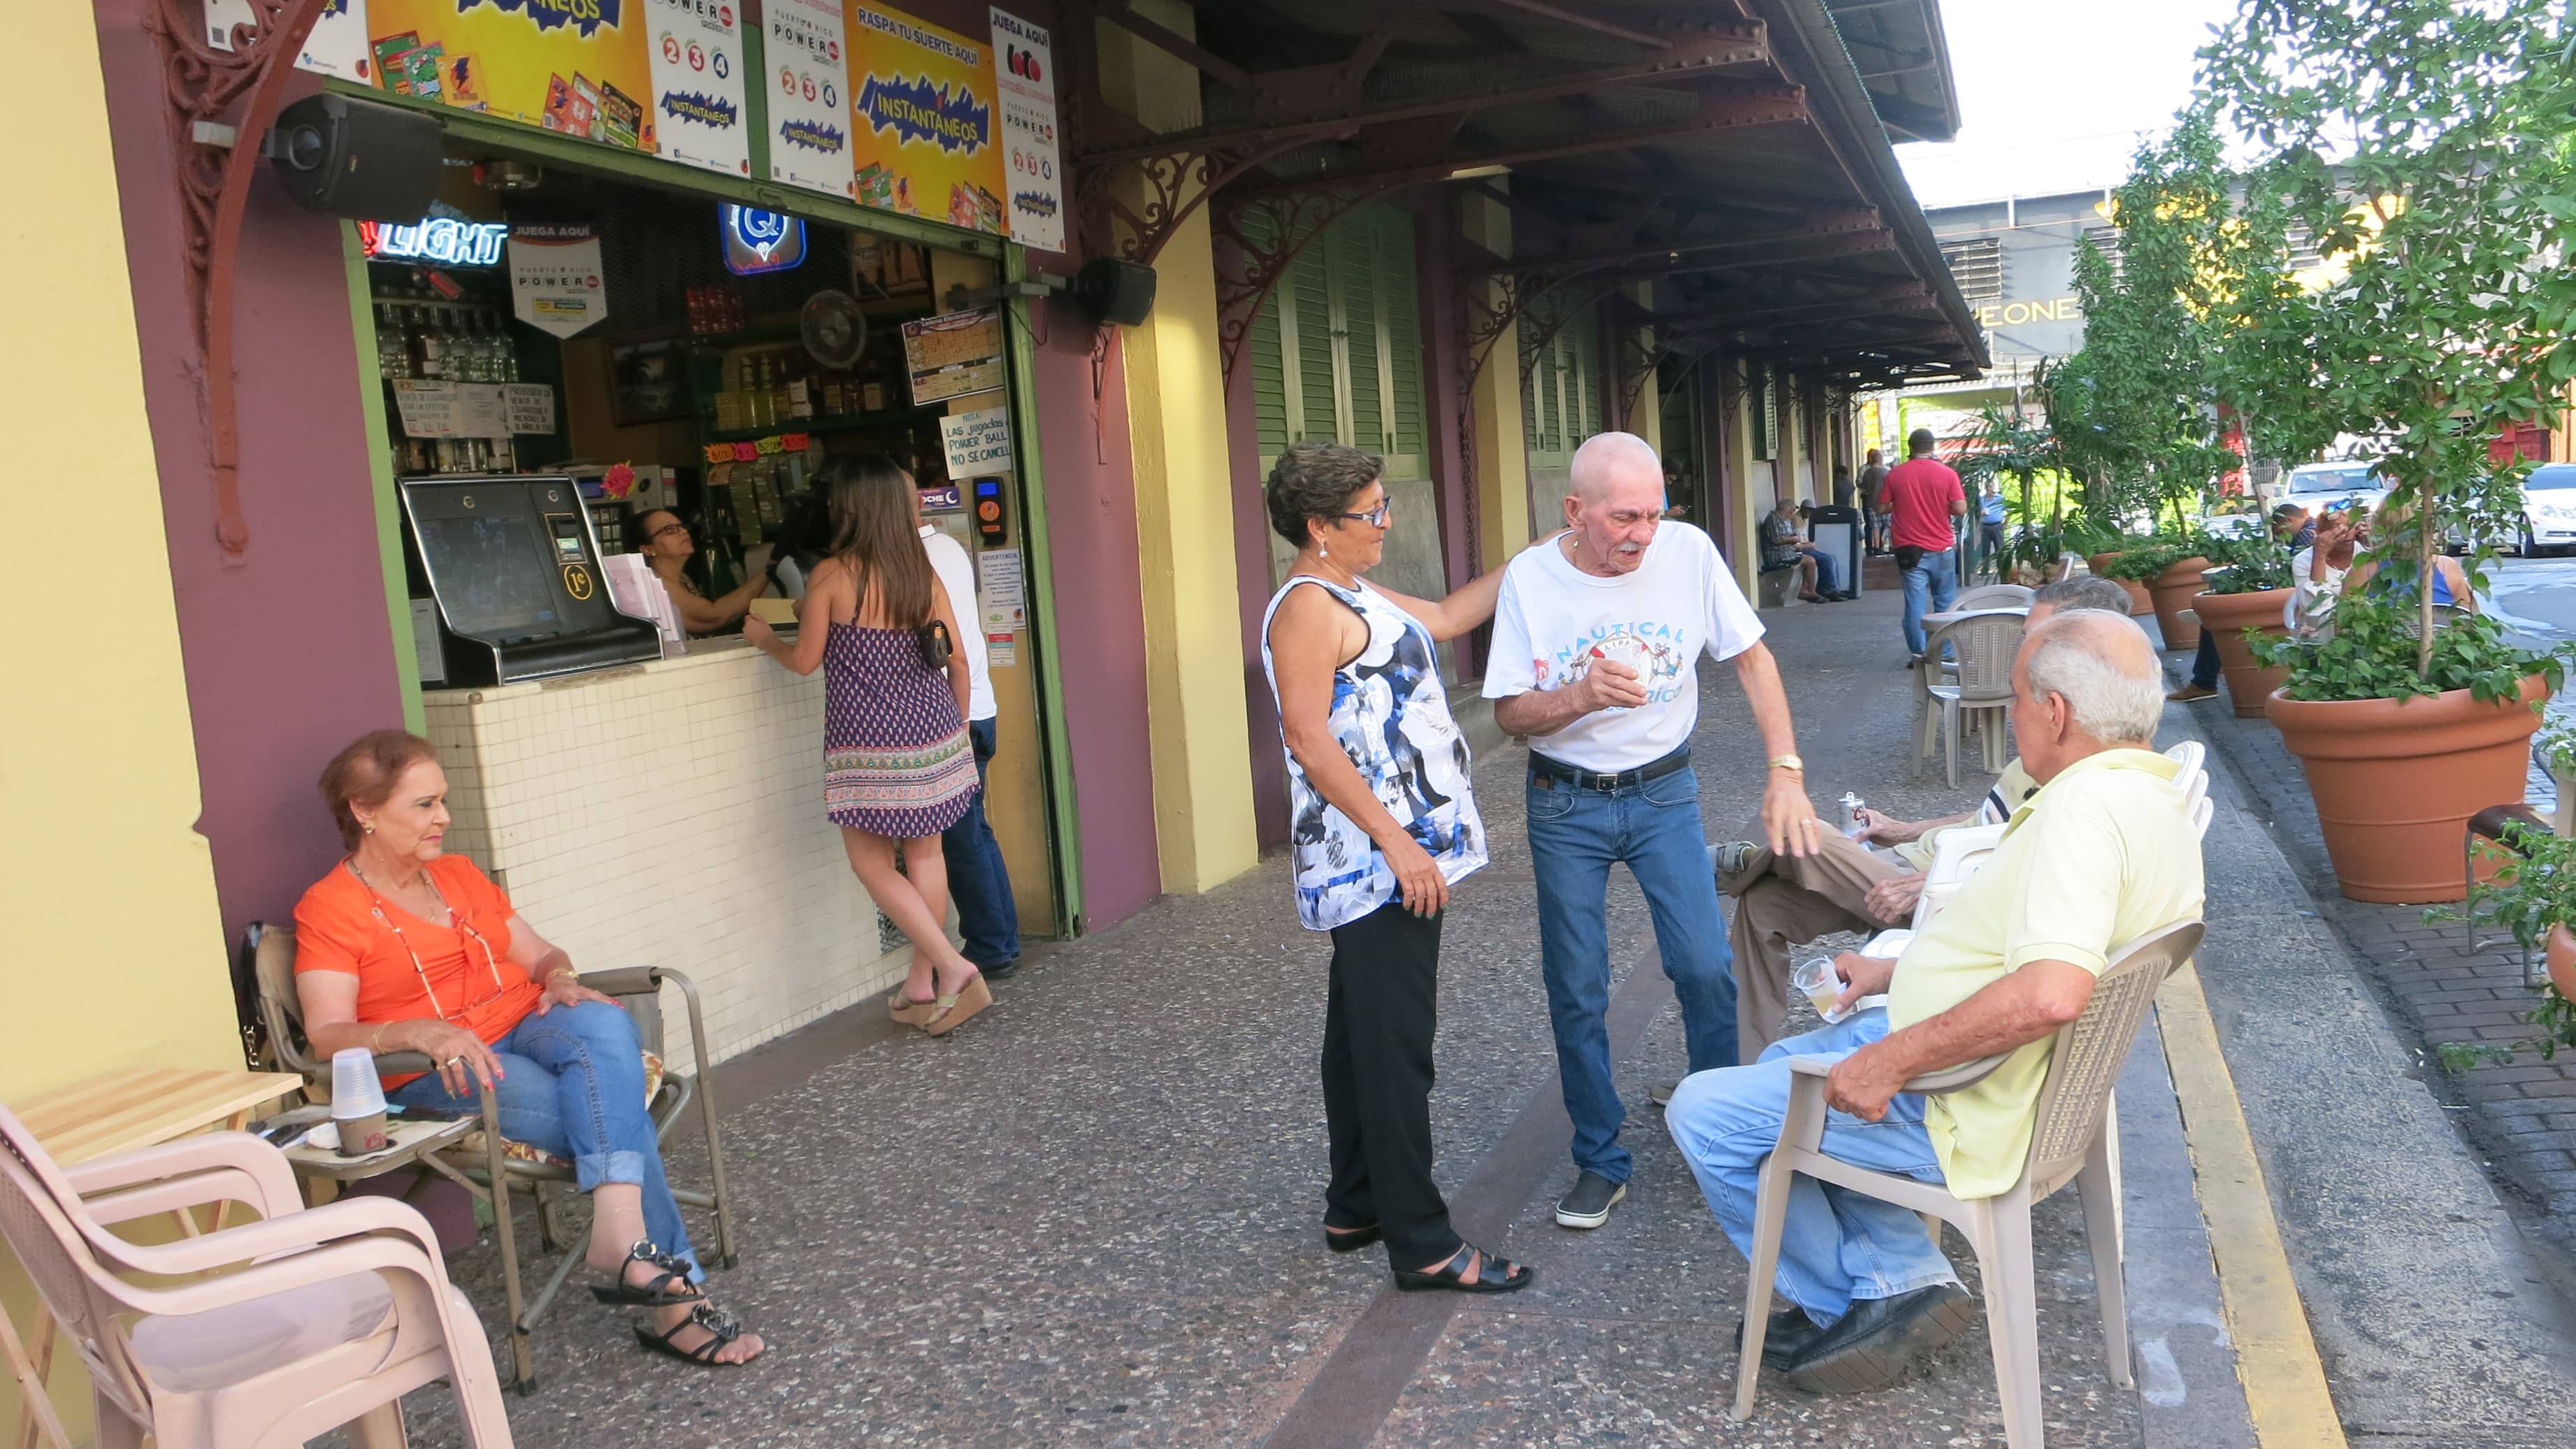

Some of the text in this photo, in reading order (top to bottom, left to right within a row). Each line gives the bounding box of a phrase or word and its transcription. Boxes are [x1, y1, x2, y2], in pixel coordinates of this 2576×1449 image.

[993, 13, 1023, 36] JUEGA
[774, 22, 826, 54] POWER
[858, 8, 896, 34] RASPA
[898, 24, 912, 41] TU
[914, 30, 953, 56] SUERTE
[955, 46, 977, 65] AQUÍ
[665, 39, 727, 76] 2 3 4
[783, 72, 835, 107] 2 3 4
[1007, 113, 1044, 135] POWER
[384, 218, 509, 265] LIGHT
[515, 226, 556, 236] JUEGA
[519, 277, 583, 286] POWER
[1974, 296, 2080, 327] EONE
[946, 426, 963, 438] LAS
[949, 431, 1007, 452] POWER BALL
[951, 454, 965, 466] NO
[981, 553, 1018, 561] ADVERTENCIA
[1557, 621, 1684, 664] NAUTICAL
